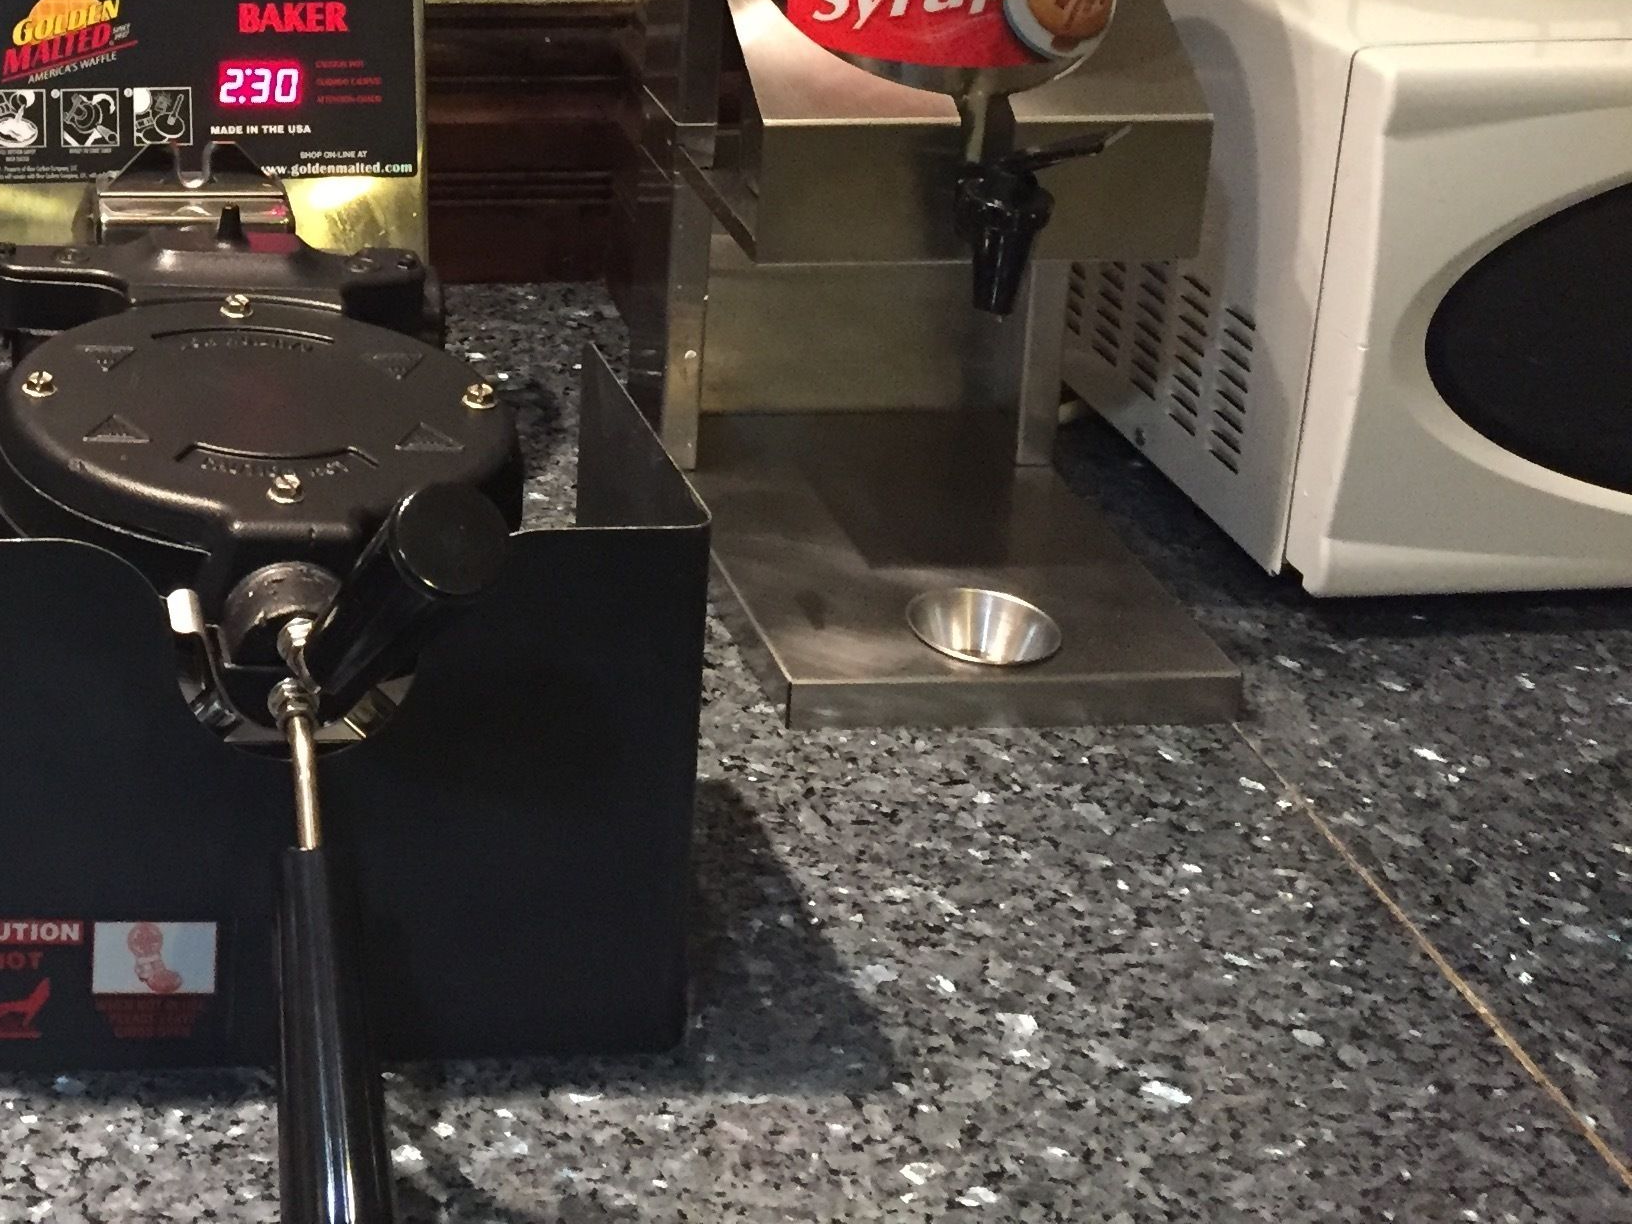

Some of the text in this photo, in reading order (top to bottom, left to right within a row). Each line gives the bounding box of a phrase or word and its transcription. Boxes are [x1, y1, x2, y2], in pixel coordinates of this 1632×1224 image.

[237, 1, 349, 33] BAKER
[2, 22, 113, 75] MALTED
[27, 51, 117, 85] AMERICA'S WAFFLE
[219, 68, 299, 104] 2:30
[210, 125, 312, 135] MADE IN THE USA
[261, 162, 413, 177] www.goldenmalted.com
[299, 151, 322, 159] SHOP
